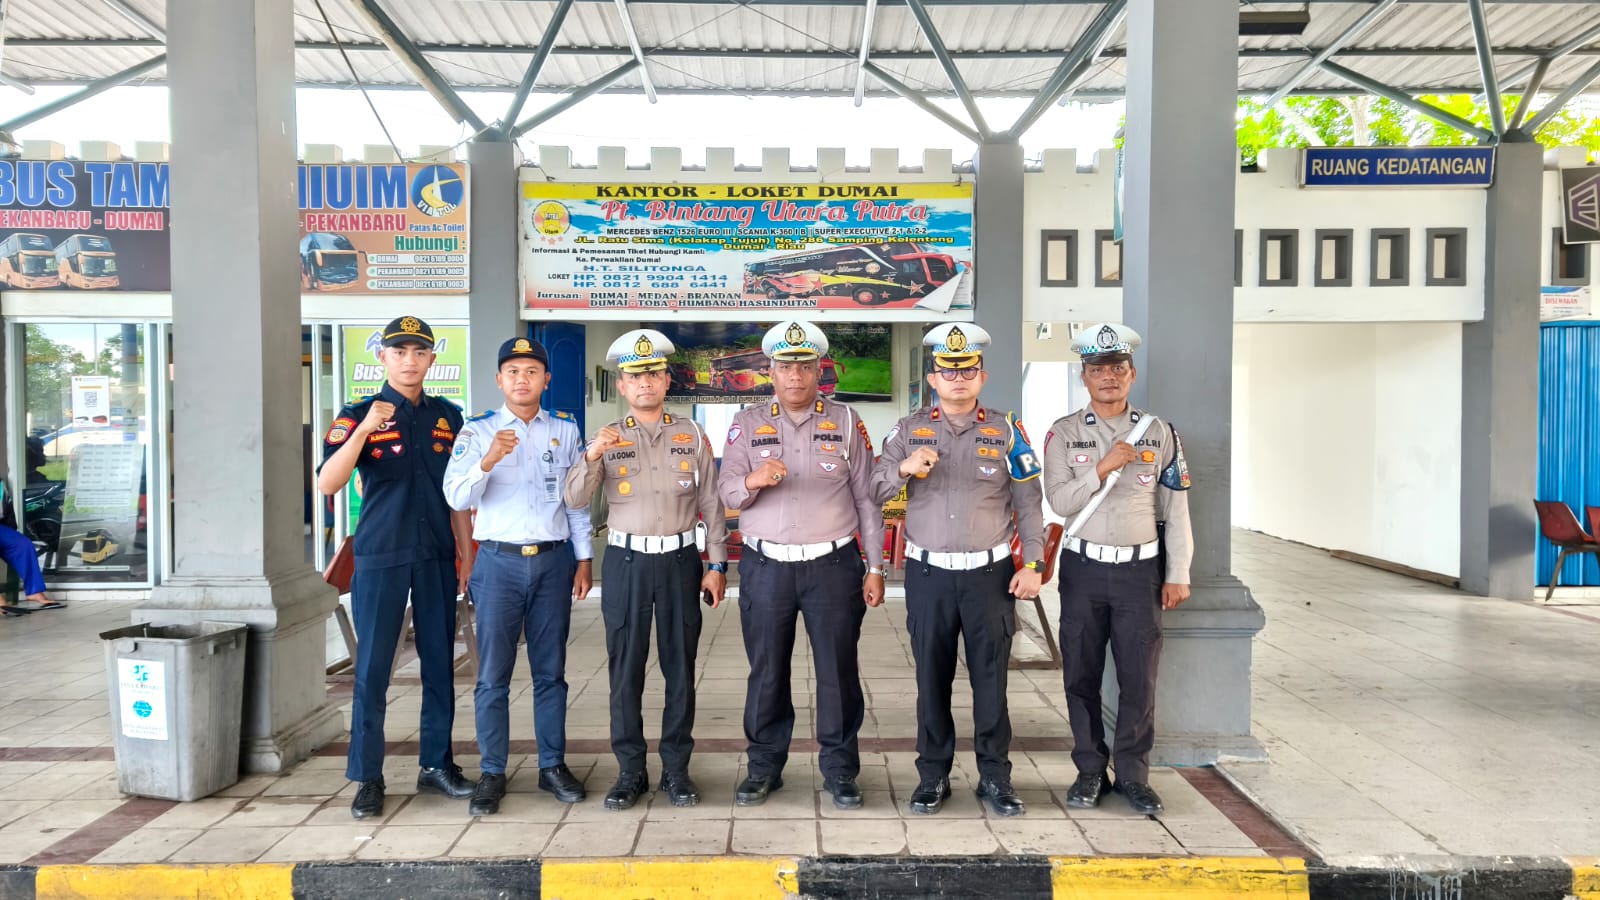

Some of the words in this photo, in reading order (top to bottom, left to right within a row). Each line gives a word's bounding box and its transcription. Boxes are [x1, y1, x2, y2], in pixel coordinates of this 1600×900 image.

[1311, 158, 1369, 176] RUANG
[1376, 157, 1487, 175] KEDATANGAN
[596, 185, 698, 198] KANTOR
[727, 185, 808, 198] LOKET
[819, 185, 899, 198] DUMAI
[600, 200, 637, 222] Pt.
[645, 200, 754, 228] Bintang
[761, 200, 848, 222] Utara
[853, 200, 930, 222] Putra
[0, 209, 91, 230] EKANBARU
[105, 211, 164, 231] DUMAI
[306, 213, 407, 232] PEKANBARU
[606, 228, 650, 236] MERCEDES
[652, 228, 674, 236] BENZ
[698, 228, 720, 236] EURO
[737, 227, 768, 235] SCANIA
[814, 227, 843, 235] SUPER
[844, 227, 890, 235] EXECUTIVE
[395, 235, 458, 252] Hubungi
[599, 236, 629, 244] Ratu
[631, 236, 665, 244] Sima
[801, 236, 824, 244] 286
[828, 236, 884, 245] Samping
[573, 273, 598, 281] HP.
[602, 273, 640, 281] 0821
[646, 273, 685, 281] 9904
[691, 273, 728, 281] 1414
[536, 291, 582, 300] Jurusan:
[590, 299, 629, 307] DUMAI
[638, 299, 668, 307] TOBA
[678, 299, 736, 307] HUMBANG
[739, 299, 817, 307] HASUNDUTAN
[353, 362, 385, 382] Bus
[813, 433, 843, 442] POLRI
[975, 436, 1005, 447] POLRI
[670, 447, 695, 456] POLRI
